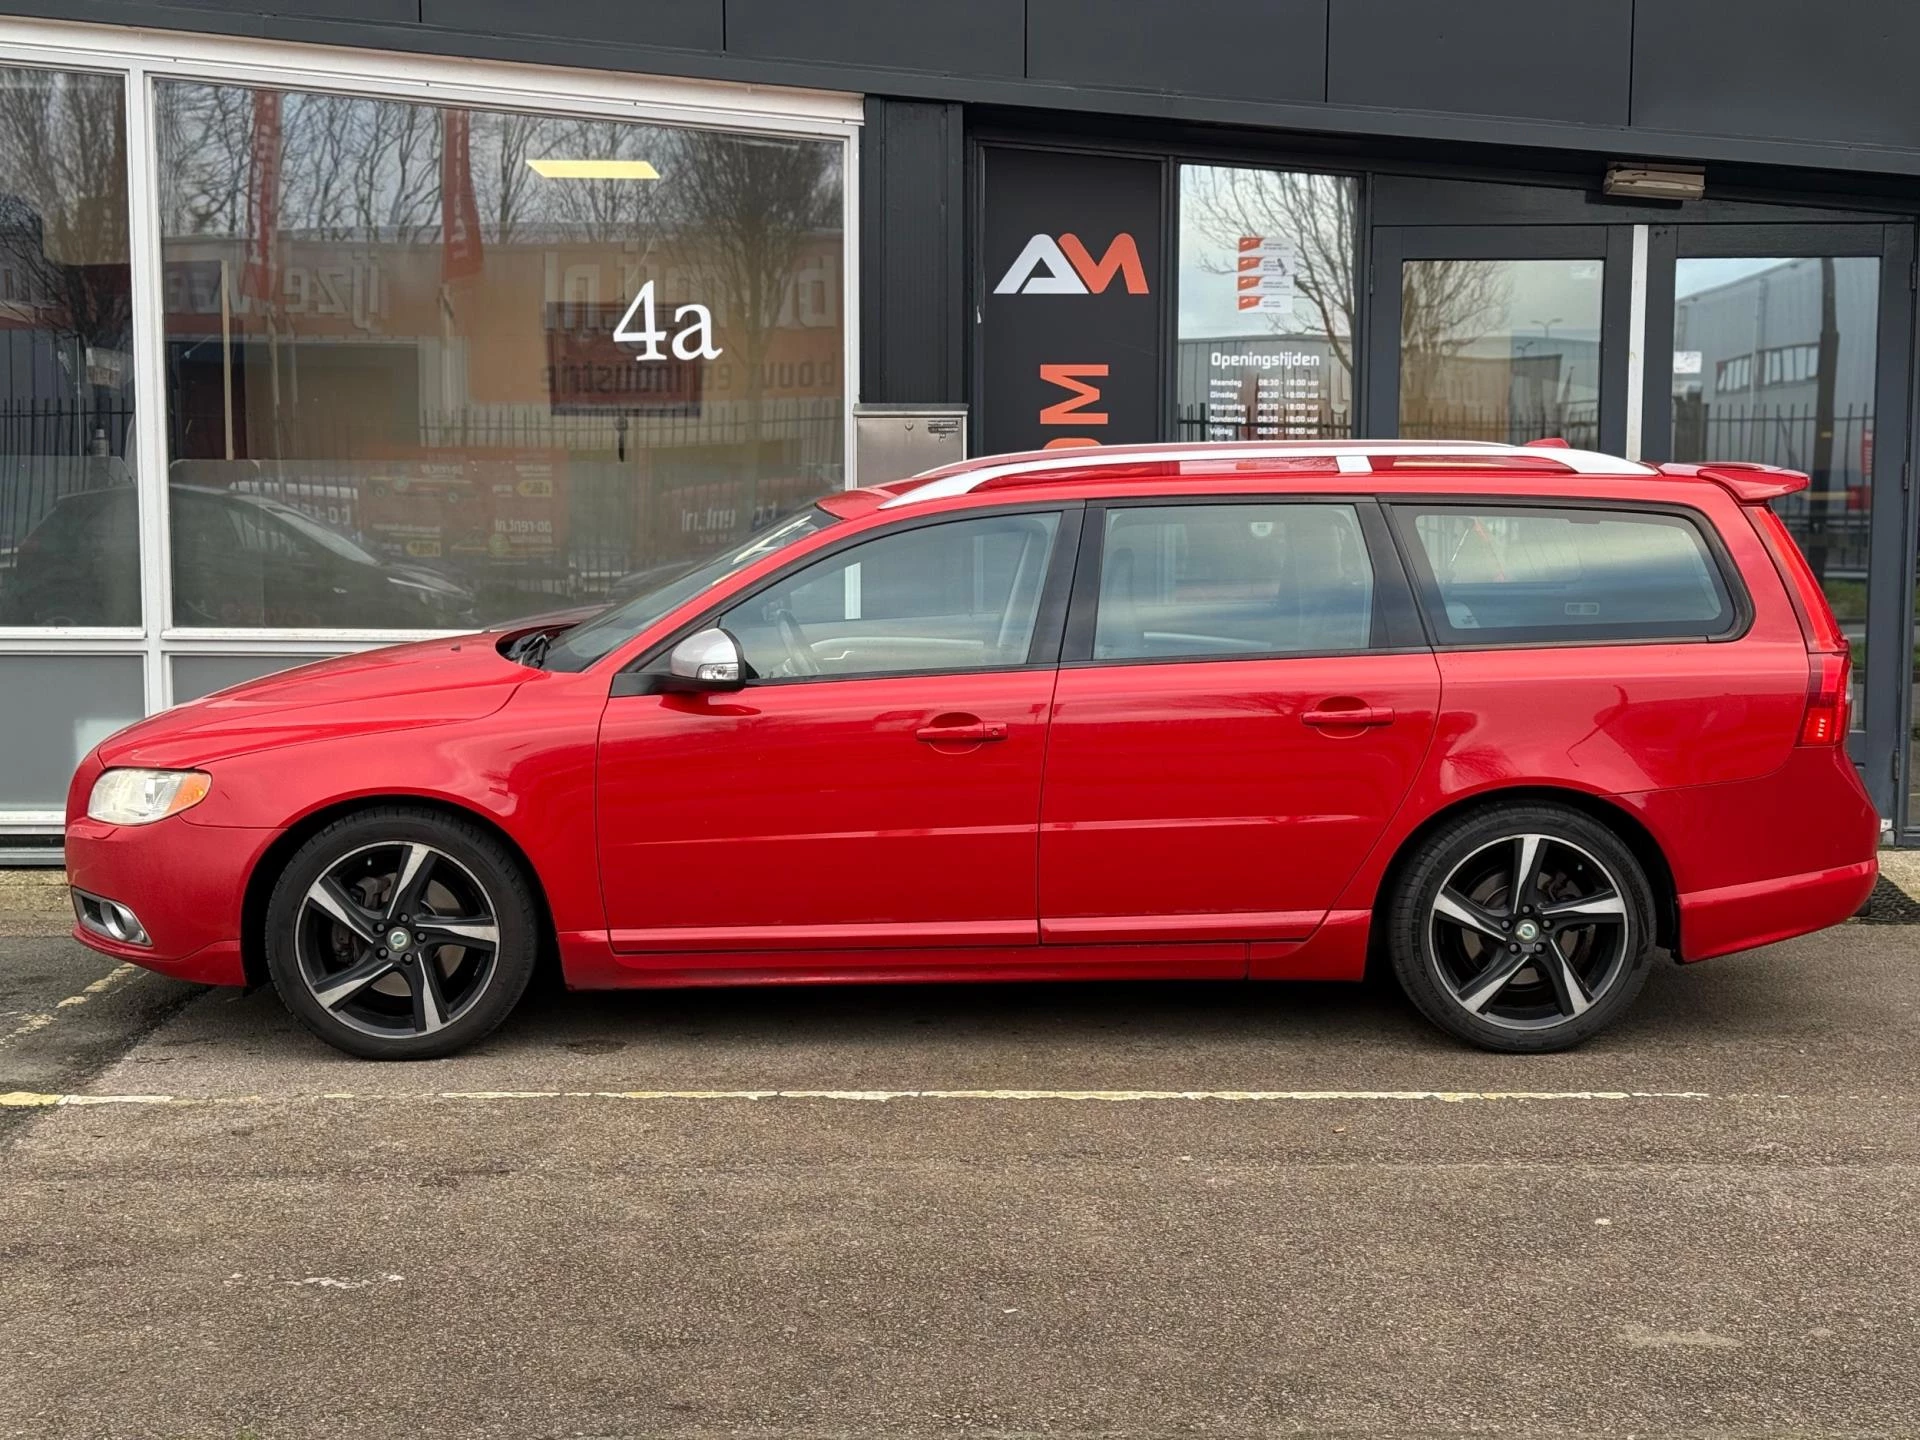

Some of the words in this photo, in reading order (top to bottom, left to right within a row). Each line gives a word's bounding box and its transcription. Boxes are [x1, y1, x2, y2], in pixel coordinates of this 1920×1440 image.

[612, 279, 724, 362] 4a
[1211, 352, 1320, 369] Openingstijden
[1210, 380, 1242, 388] Maandag
[1209, 391, 1238, 400] Dinsdag
[1039, 364, 1109, 451] M
[1209, 403, 1246, 412] Woensdag
[1209, 415, 1247, 424] Donderdag
[1307, 427, 1318, 435] uur
